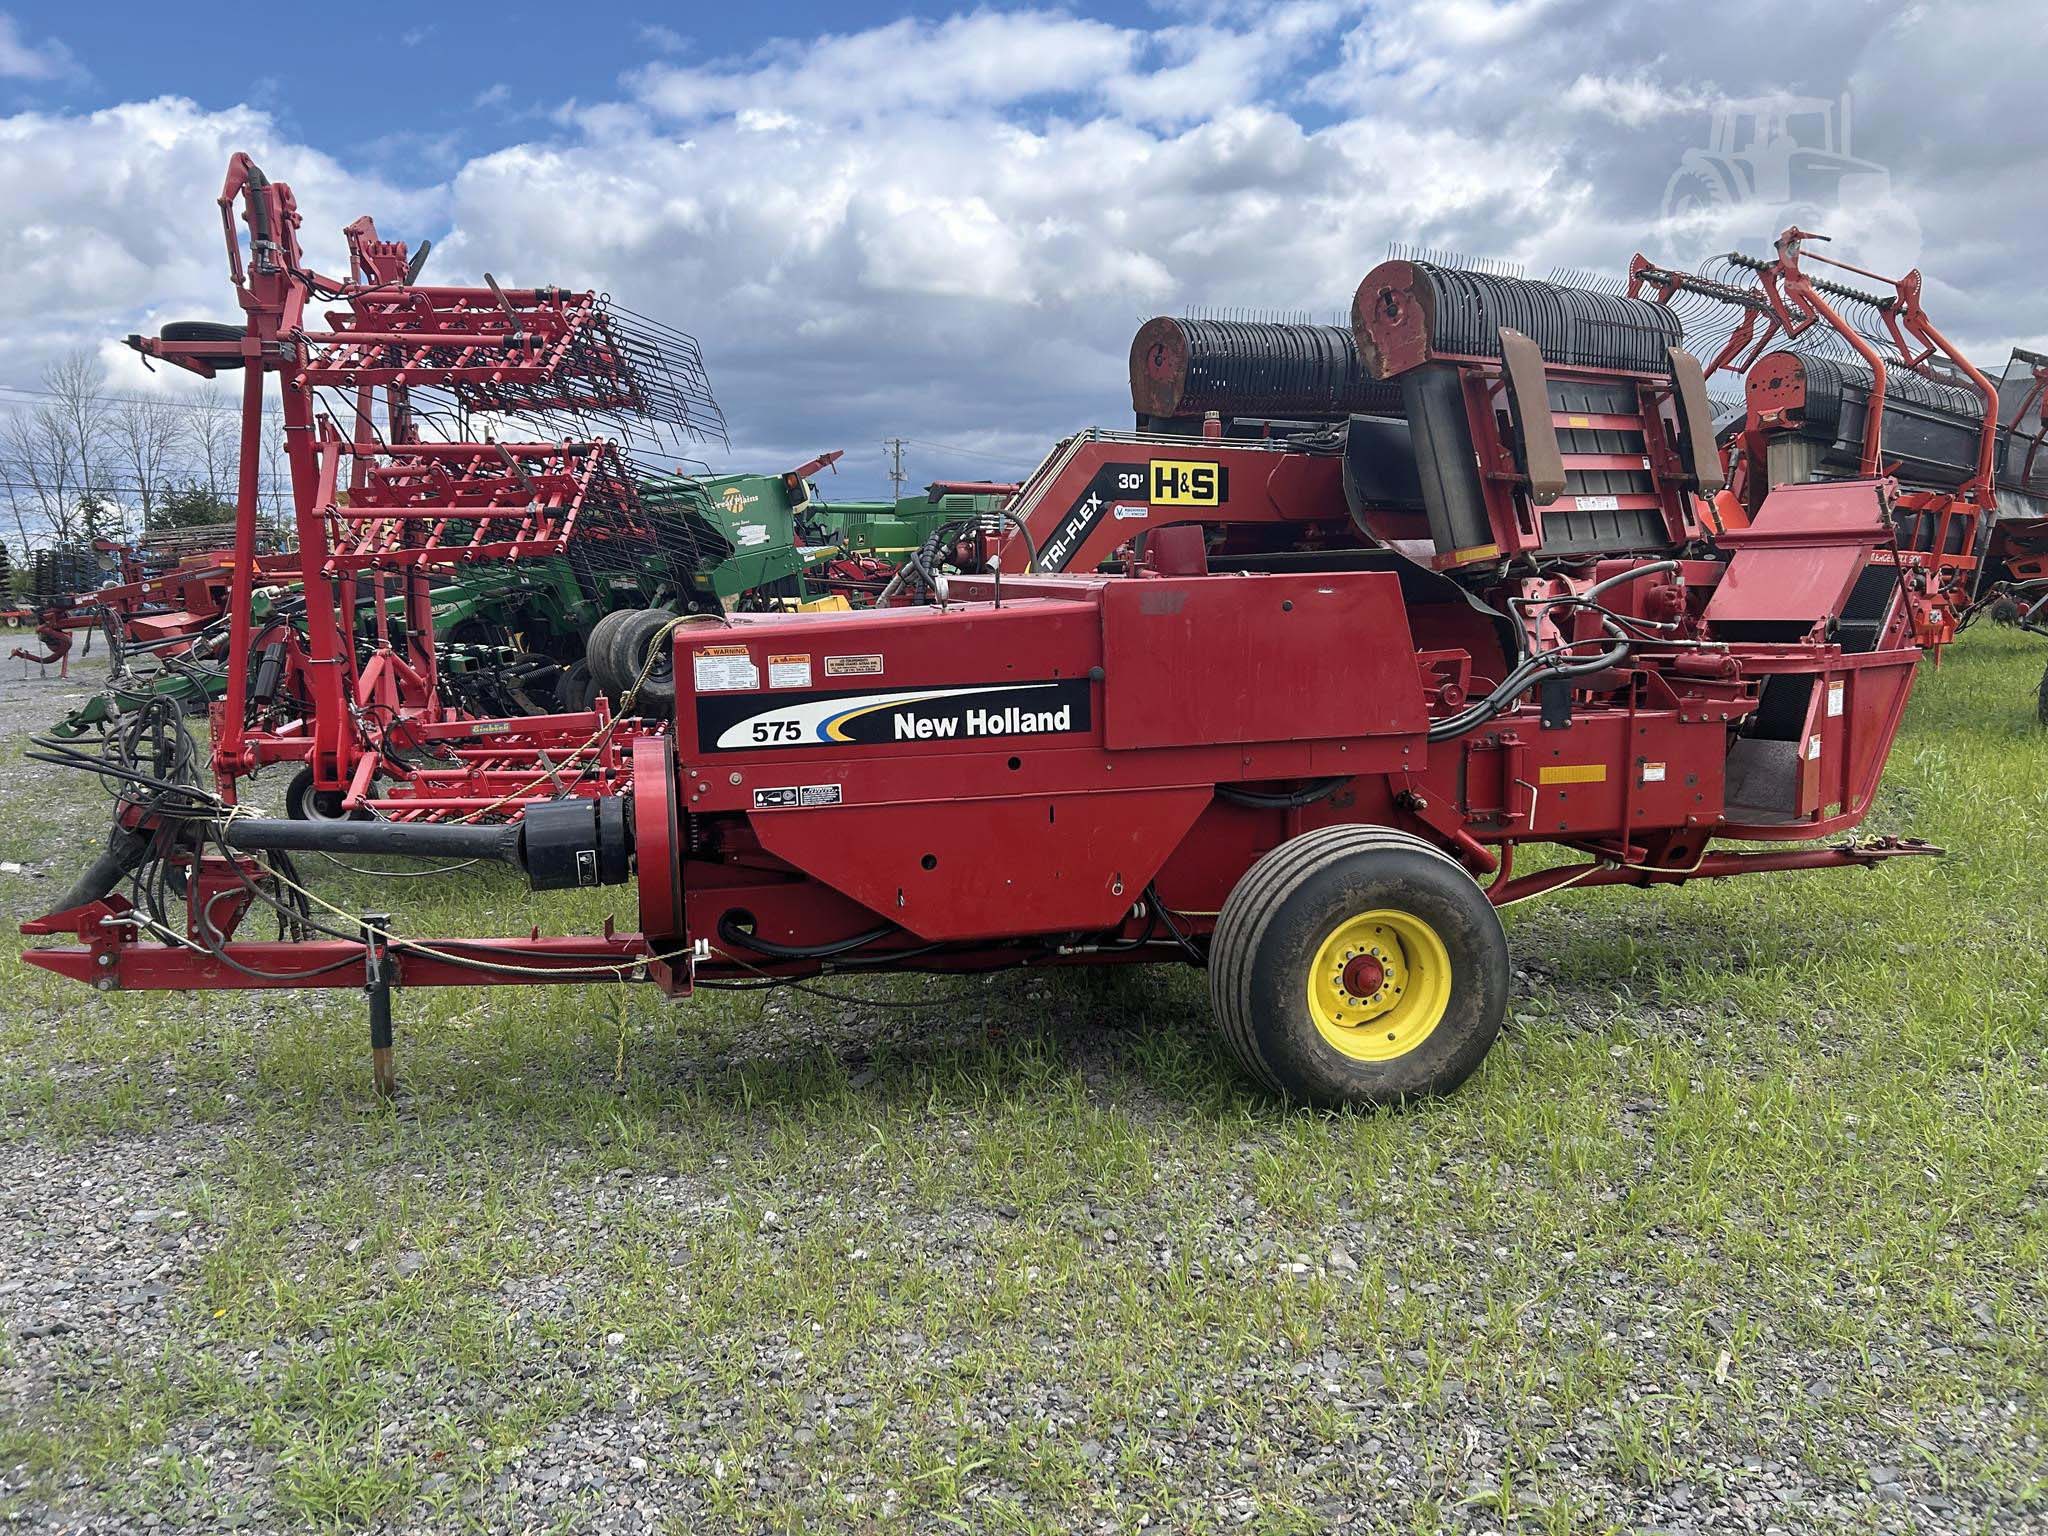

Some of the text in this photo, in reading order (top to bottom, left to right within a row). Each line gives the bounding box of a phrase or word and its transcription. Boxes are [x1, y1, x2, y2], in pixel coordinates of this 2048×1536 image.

[1119, 473, 1143, 489] 30'
[1155, 466, 1214, 500] H&S
[1040, 491, 1103, 571] TRI-FLEX
[752, 721, 801, 742] 575
[894, 704, 1071, 739] New Holland
